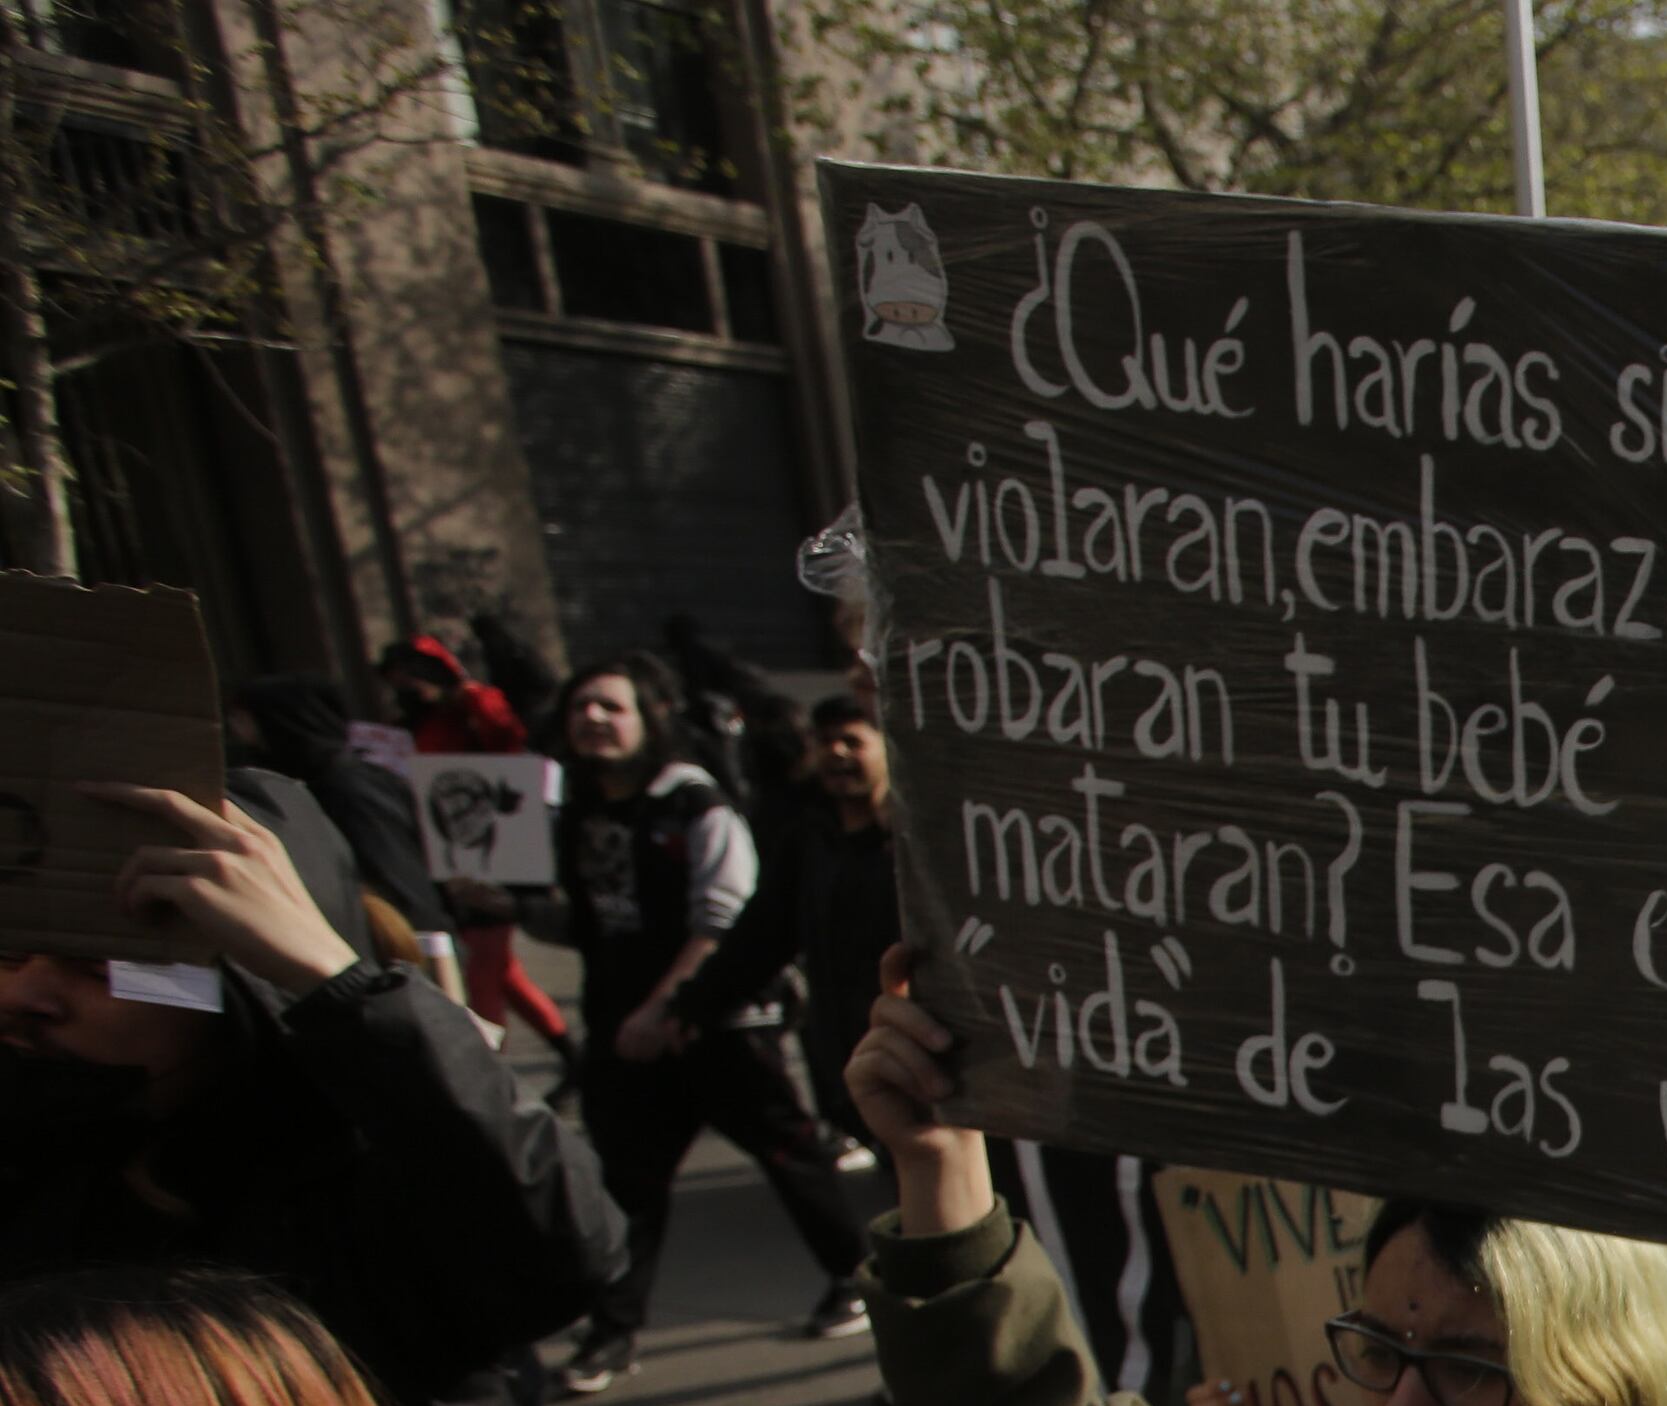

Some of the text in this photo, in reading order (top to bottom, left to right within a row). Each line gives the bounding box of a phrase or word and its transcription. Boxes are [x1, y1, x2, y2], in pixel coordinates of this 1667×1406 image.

[1011, 207, 1255, 418] ¿Qué
[1288, 229, 1561, 450] harías
[907, 577, 1234, 767] robaran
[1286, 631, 1388, 789] tu
[1414, 636, 1618, 816] bebé
[961, 764, 1365, 978] mataran?
[1397, 802, 1576, 972] Esa
[1236, 959, 1350, 1119] de
[1417, 980, 1584, 1159] las
